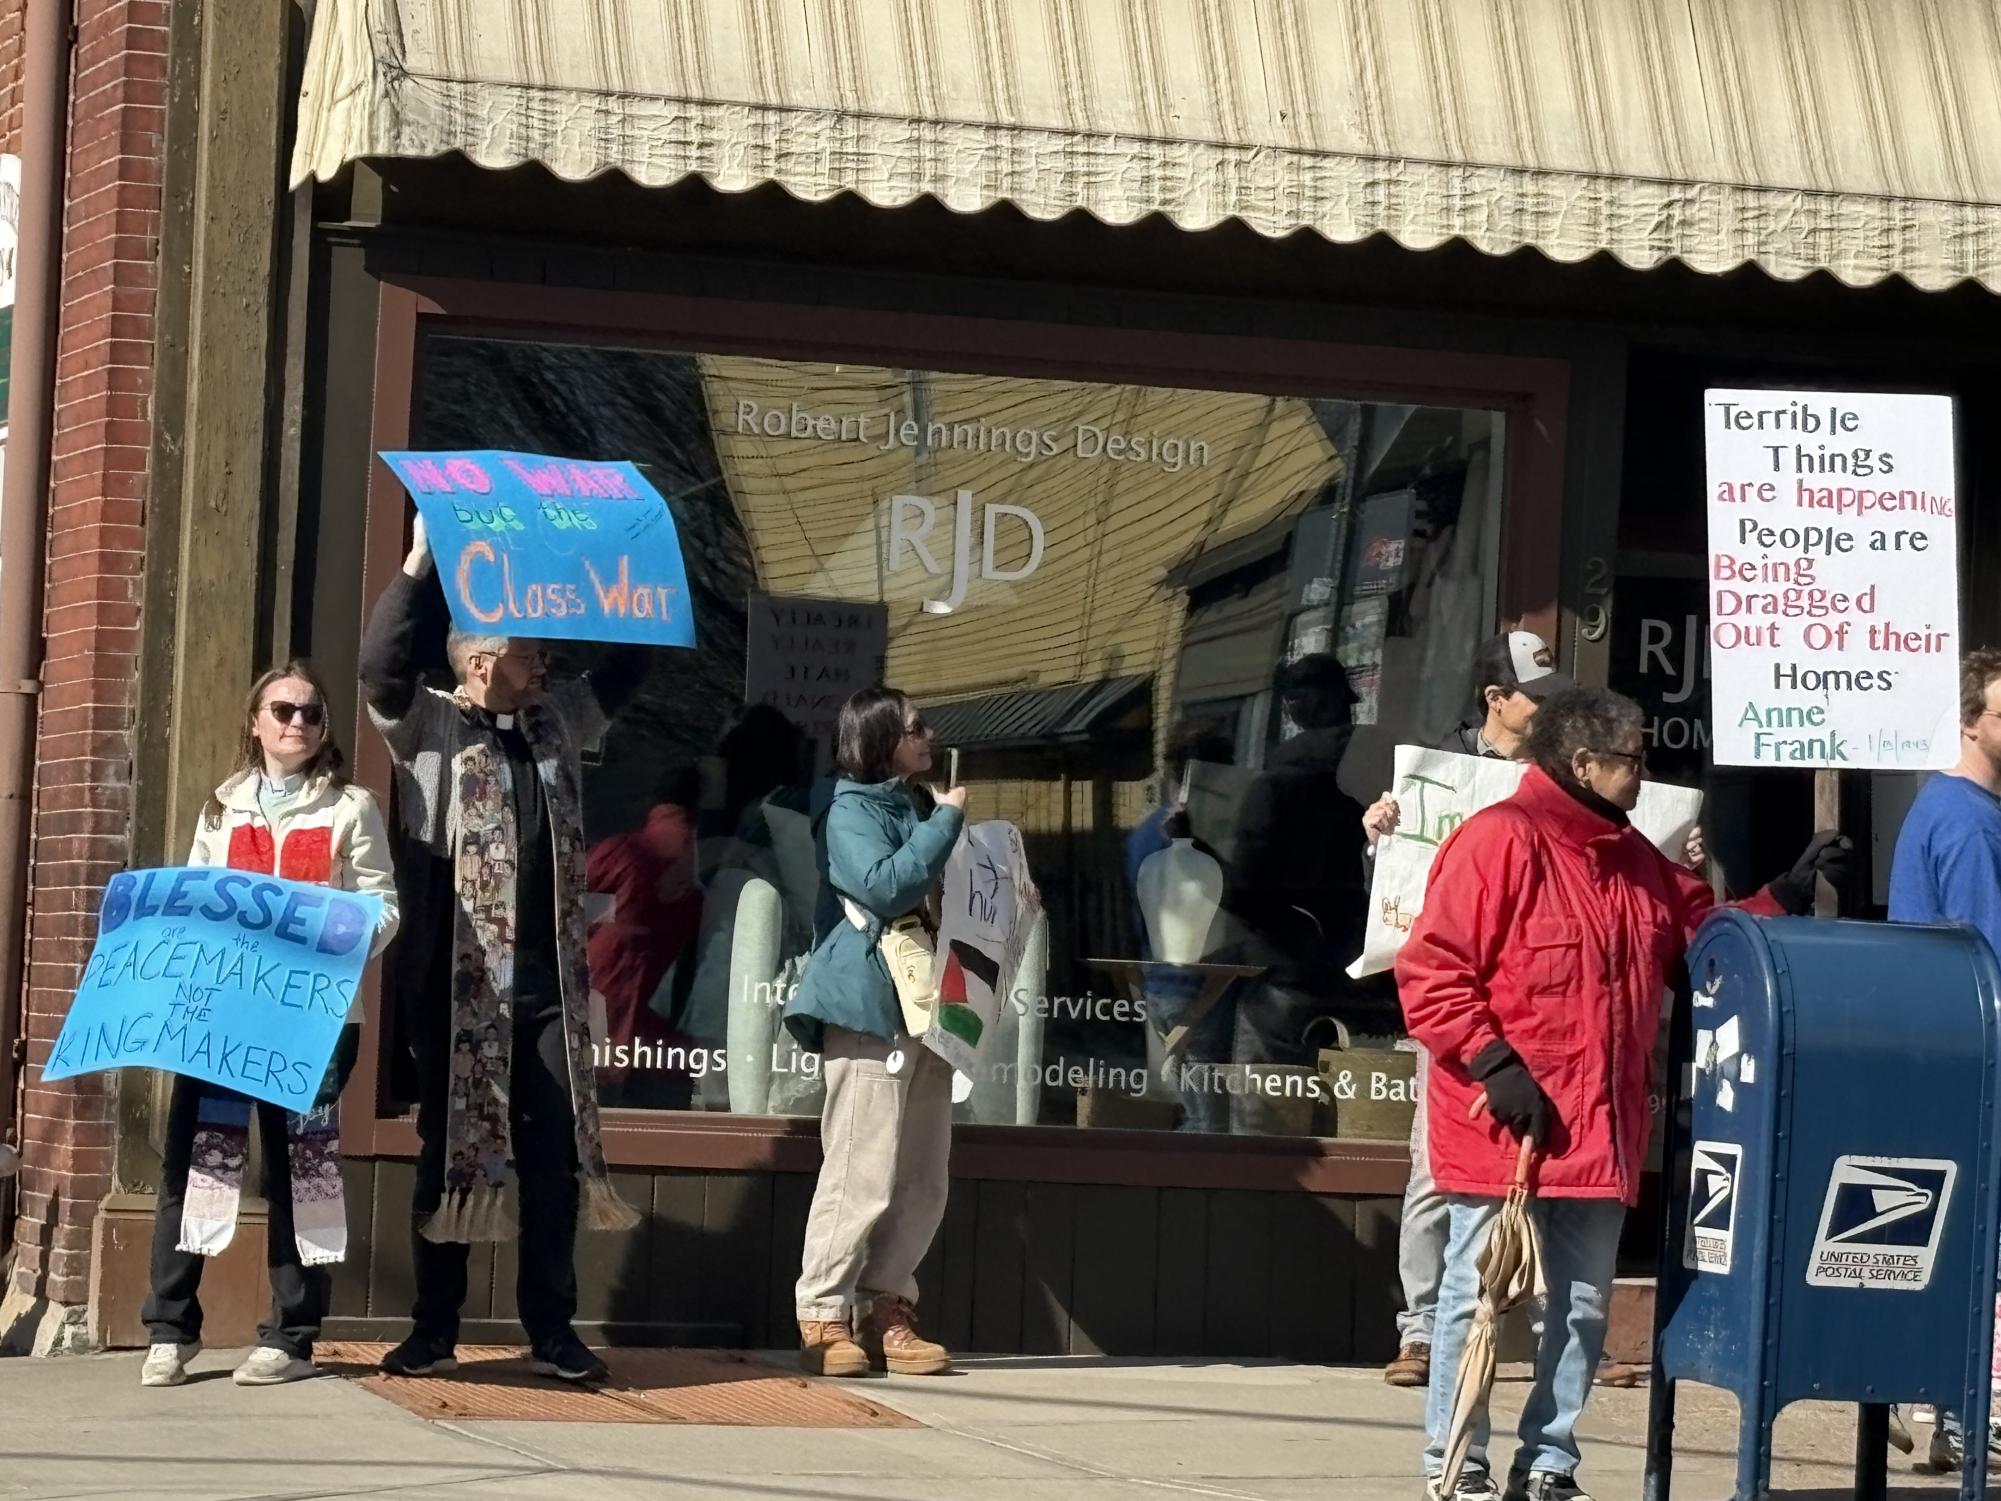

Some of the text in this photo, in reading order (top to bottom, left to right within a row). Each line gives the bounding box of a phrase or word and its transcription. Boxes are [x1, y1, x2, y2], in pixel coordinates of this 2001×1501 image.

[1714, 400, 1859, 436] Terrible
[737, 400, 1210, 473] Robert Jennings Design
[1762, 443, 1895, 477] Things
[399, 458, 645, 500] NO WAR
[1717, 481, 1777, 503] are
[453, 502, 521, 529] but
[538, 500, 596, 529] the
[887, 488, 1045, 614] RJD
[1738, 517, 1930, 555] People are
[456, 540, 678, 623] Class War
[1713, 553, 1817, 587] Being
[1716, 583, 1876, 618] Dragged
[1713, 621, 1951, 653] Out Of their
[1639, 614, 1712, 704] RJ
[1773, 662, 1893, 692] Homes
[1737, 701, 1826, 728] Anne
[101, 870, 369, 956] BLESSED
[161, 925, 260, 954] are the
[83, 940, 355, 1019] PEACEMAKERS
[175, 981, 222, 1005] NOT
[168, 1002, 213, 1023] THE
[1013, 987, 1149, 1023] Services
[771, 1042, 821, 1081] Lig
[991, 1055, 1149, 1097] modeling
[1180, 1063, 1321, 1098] Kitchens
[1333, 1069, 1357, 1100] &
[1370, 1070, 1419, 1102] Bat
[1815, 1265, 1923, 1282] POSTAL SERVICE
[1819, 1250, 1919, 1266] UNITED STATES
